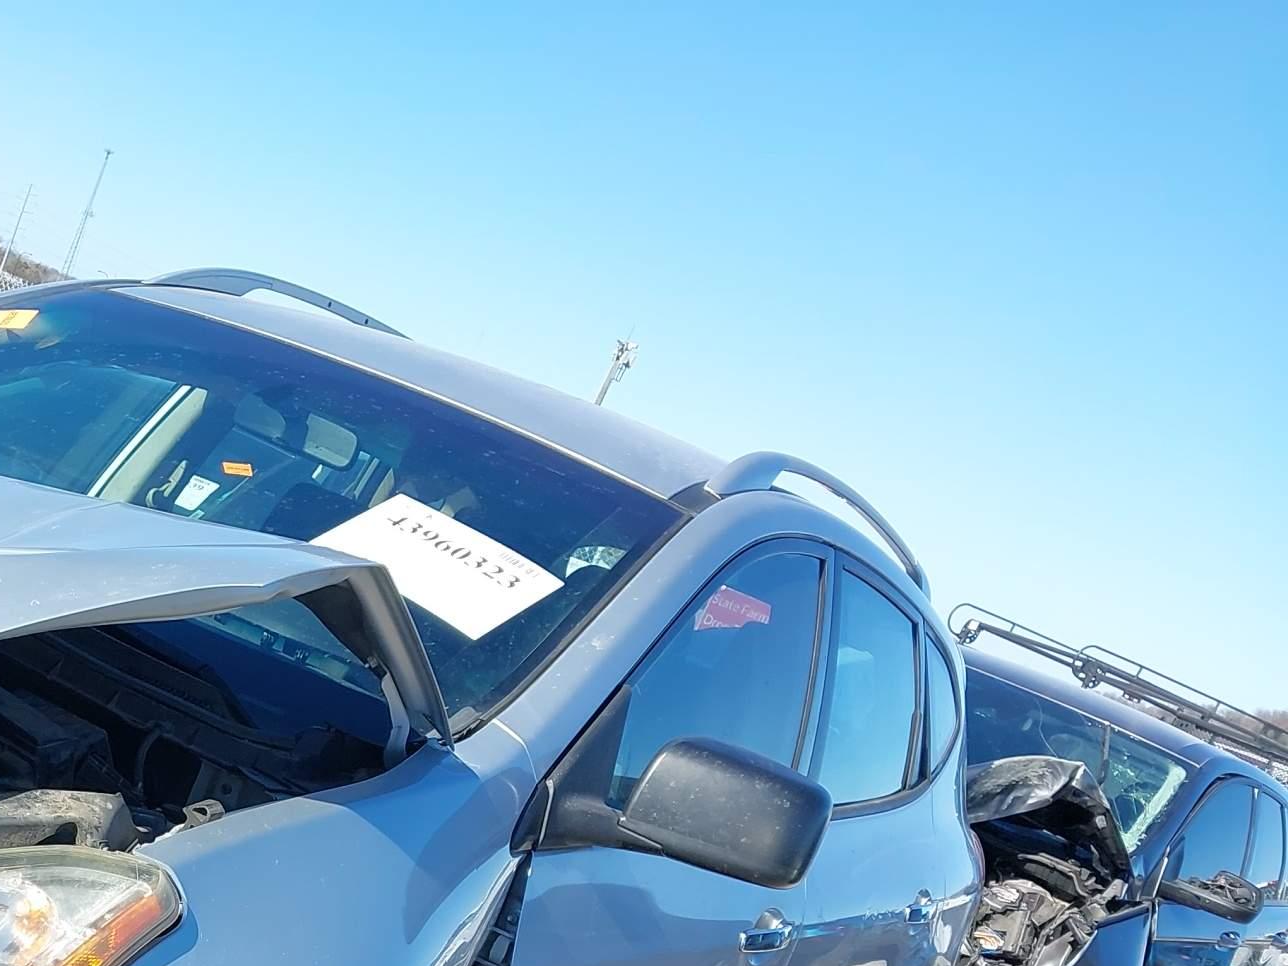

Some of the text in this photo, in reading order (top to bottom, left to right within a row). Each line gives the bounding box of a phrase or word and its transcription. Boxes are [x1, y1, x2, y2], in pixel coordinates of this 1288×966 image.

[387, 516, 521, 589] 43960323
[711, 593, 770, 625] State Farm
